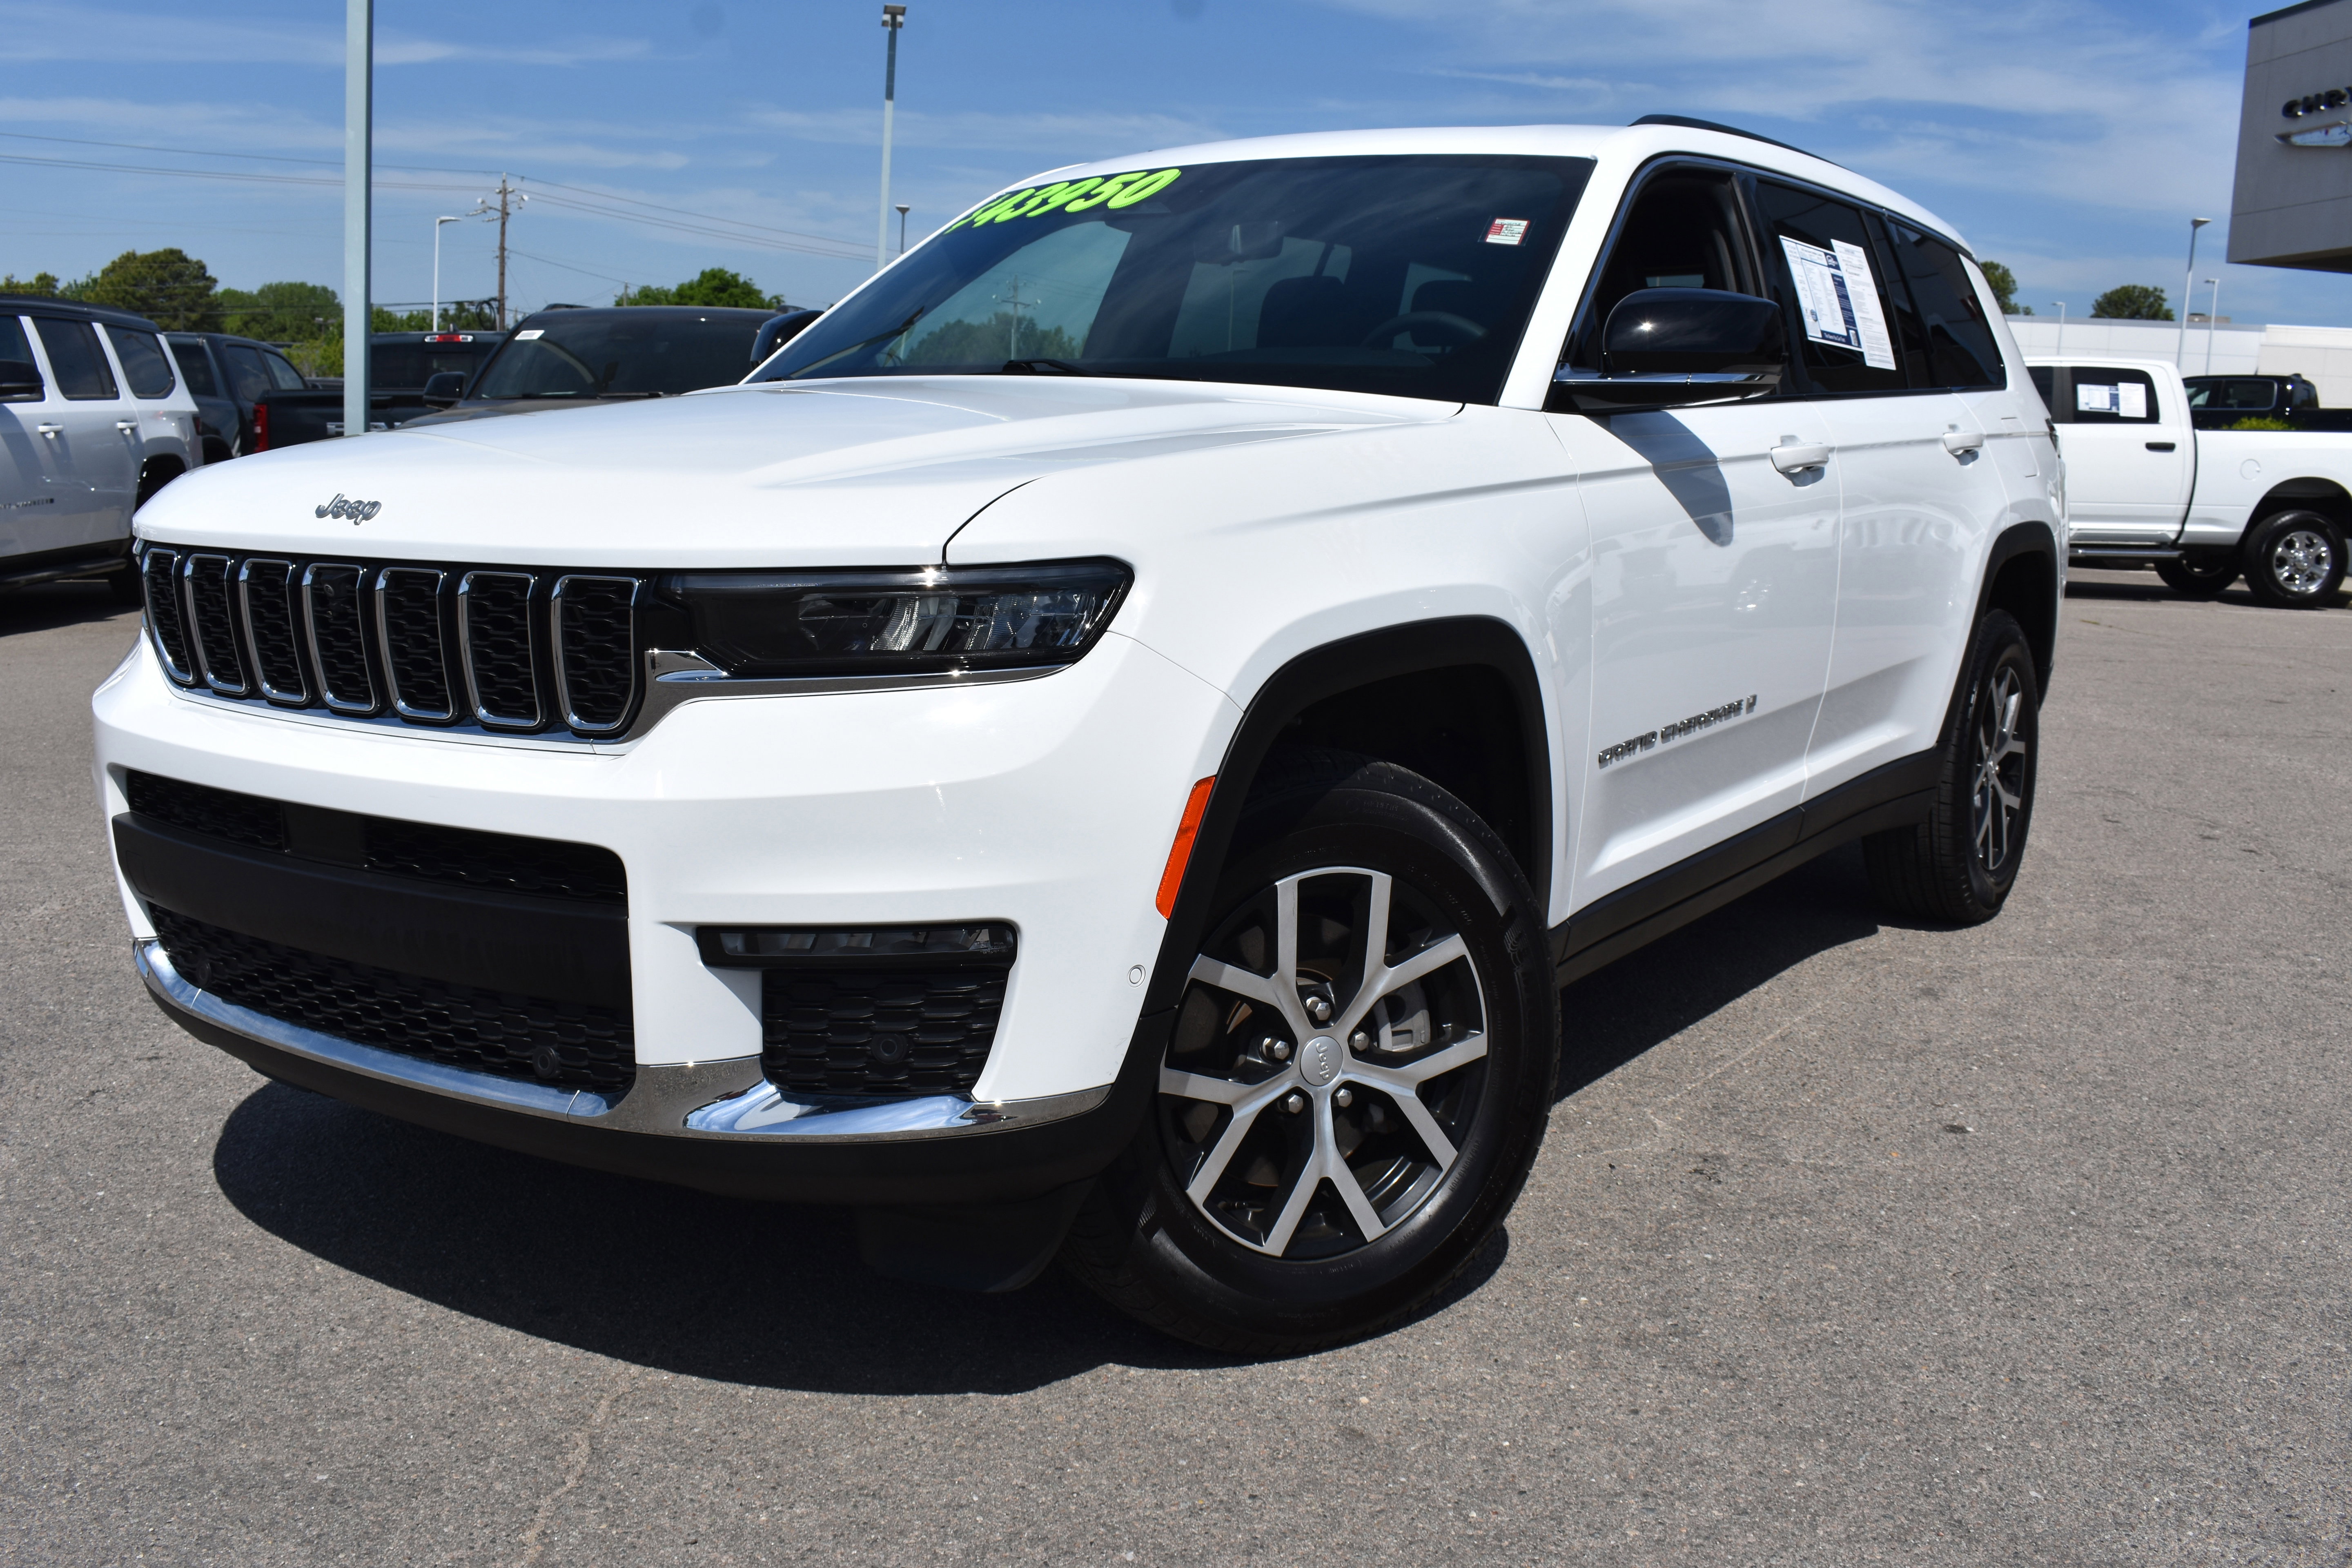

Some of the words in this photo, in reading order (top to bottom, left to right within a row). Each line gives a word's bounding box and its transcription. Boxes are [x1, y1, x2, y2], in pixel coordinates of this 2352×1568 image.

[314, 493, 382, 526] Jeep
[1598, 731, 1658, 764] GRAND
[1661, 699, 1744, 740] CHEROKEE
[1316, 1042, 1330, 1080] Jeep
